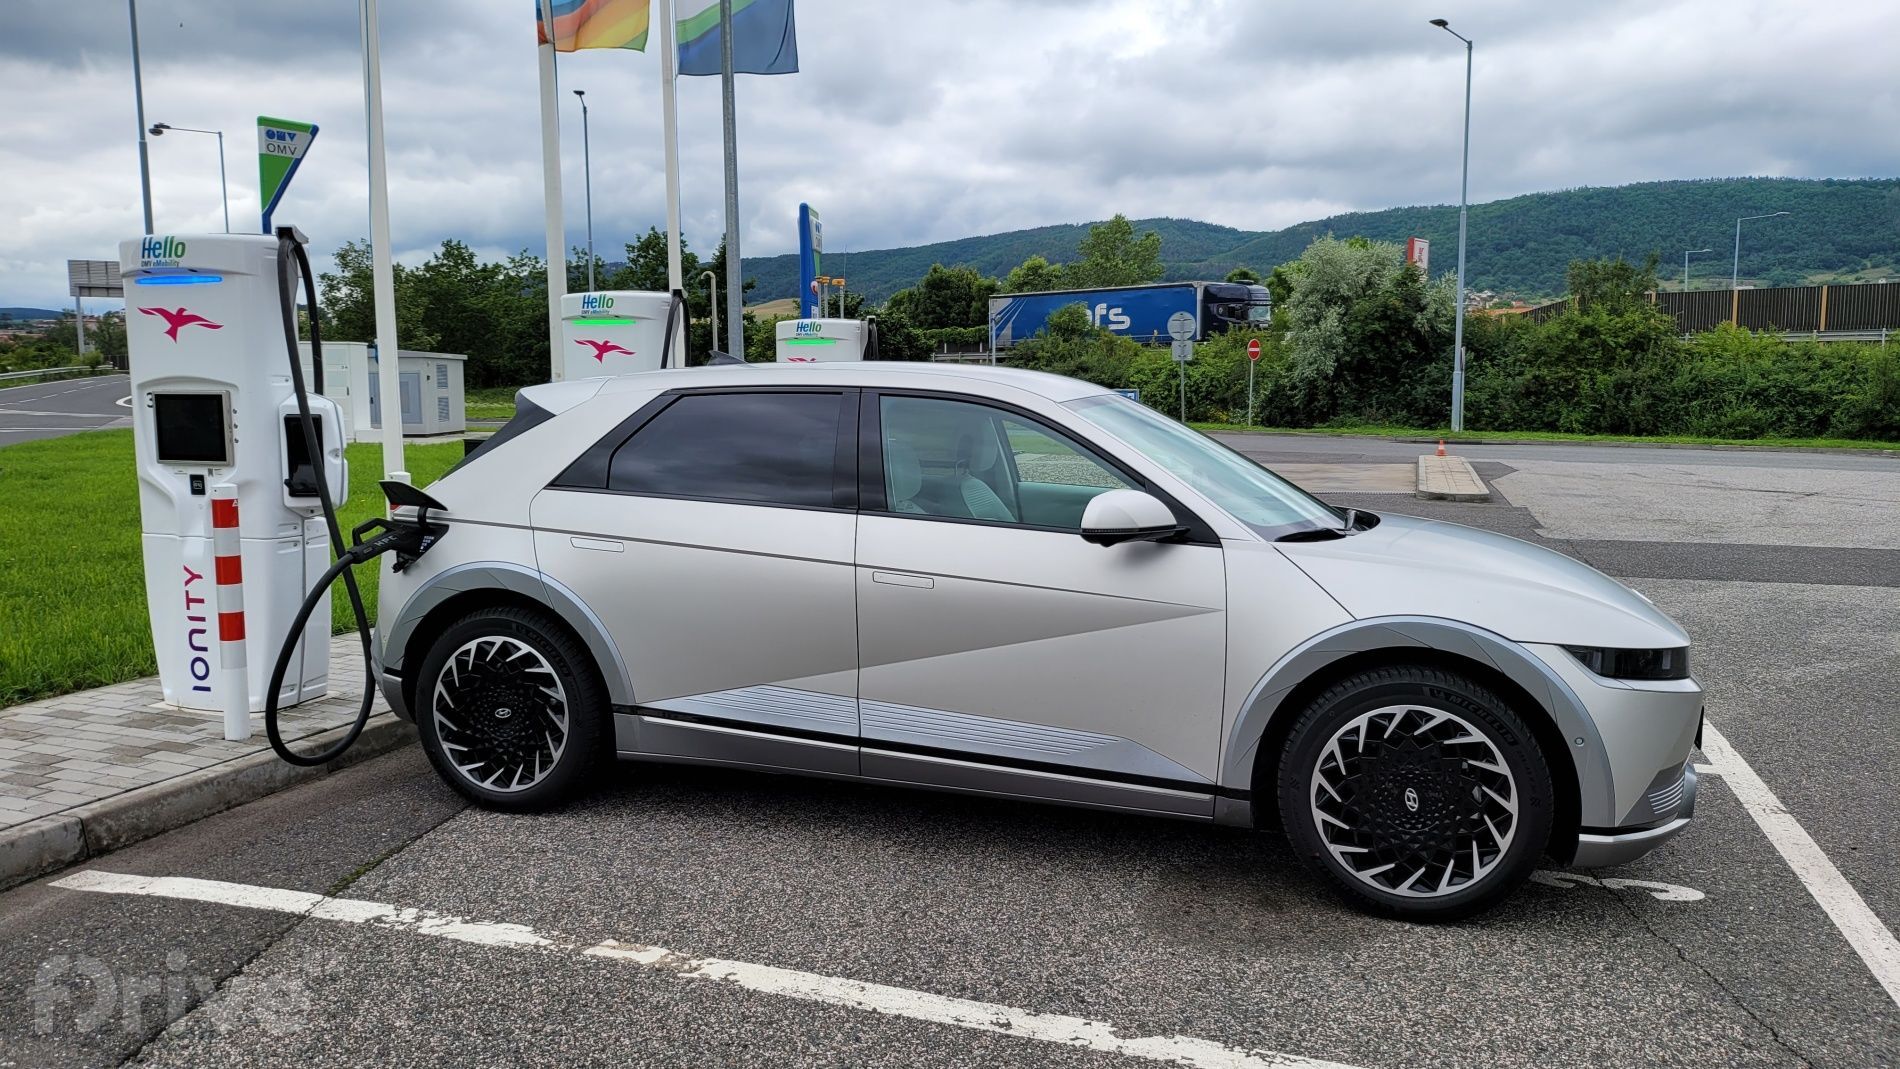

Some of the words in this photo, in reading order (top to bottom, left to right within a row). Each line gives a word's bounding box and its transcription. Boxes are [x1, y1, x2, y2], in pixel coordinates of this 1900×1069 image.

[266, 143, 298, 156] OMV
[142, 236, 186, 259] Hello
[582, 294, 615, 309] Hello
[796, 321, 822, 333] Hello
[146, 392, 154, 408] 3
[1448, 694, 1516, 744] MICHELIN
